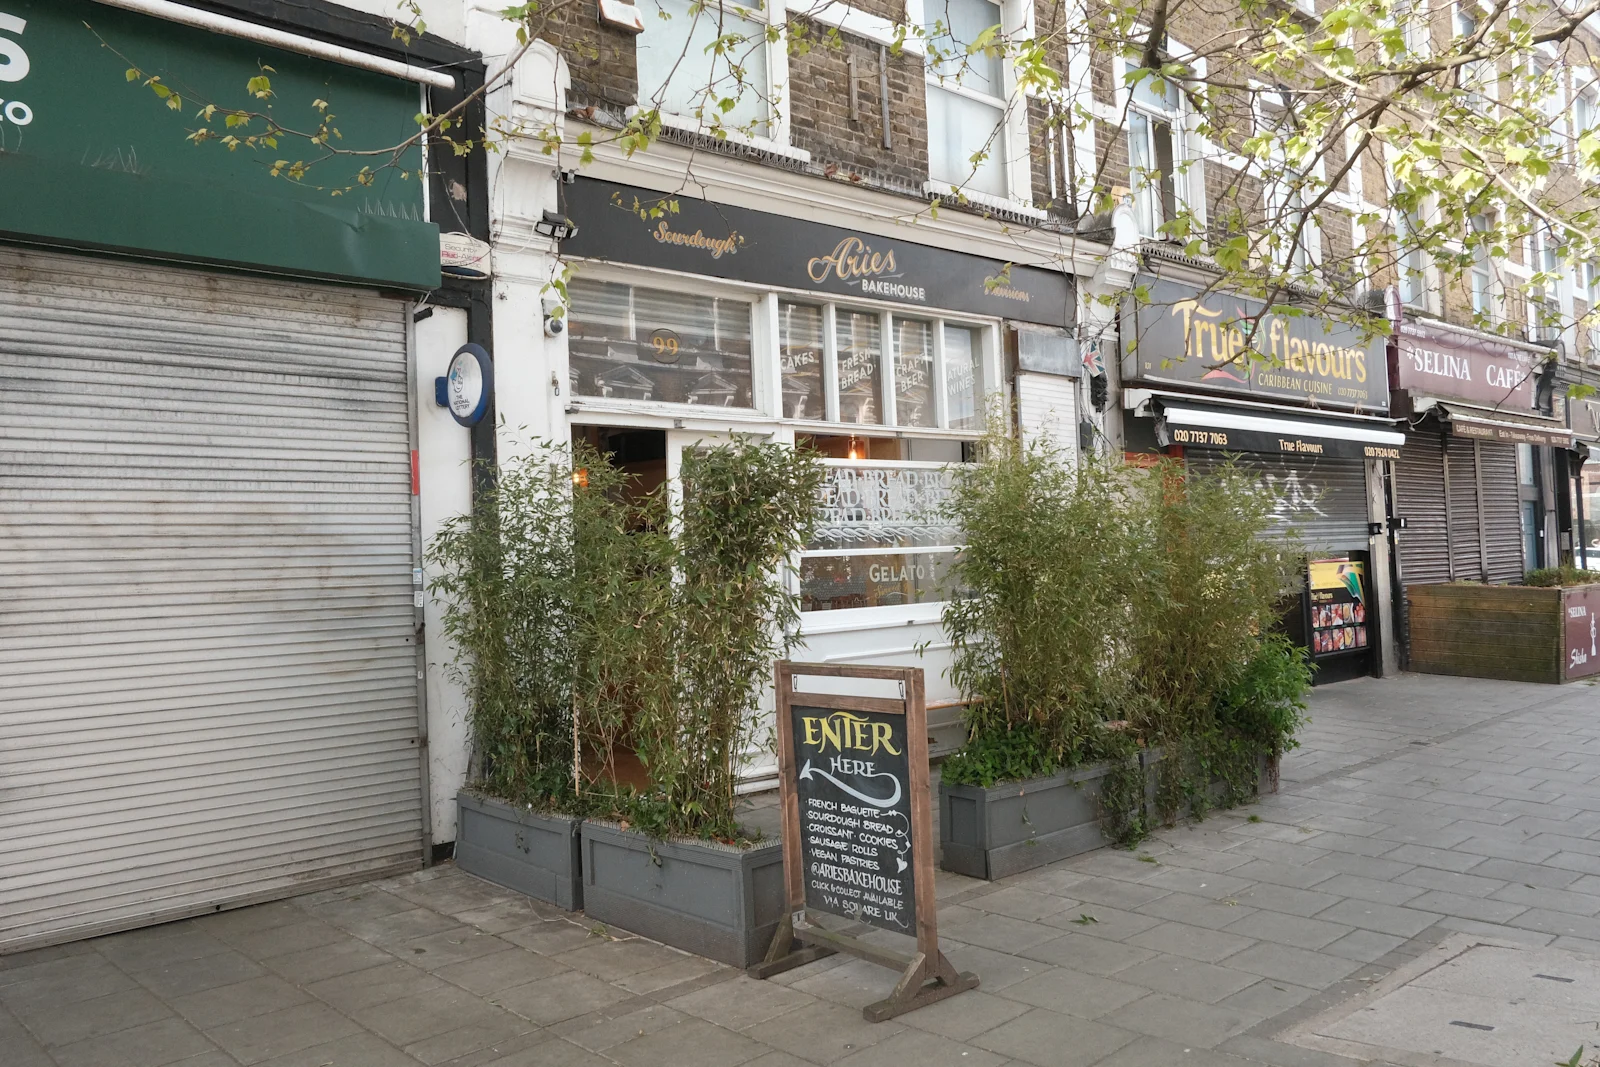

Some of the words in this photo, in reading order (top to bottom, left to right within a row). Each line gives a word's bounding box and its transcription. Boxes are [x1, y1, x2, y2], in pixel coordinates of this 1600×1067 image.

[654, 220, 737, 259] Sourdough
[807, 237, 897, 283] Aries
[861, 279, 926, 300] BAKEHOUSE
[1171, 298, 1244, 363] True
[653, 336, 679, 356] 99
[1270, 318, 1367, 383] flavours
[781, 351, 814, 371] CAKES
[842, 348, 871, 372] FRESH
[896, 353, 925, 377] CRAFT
[947, 357, 980, 381] ATURAL
[1414, 347, 1472, 381] SELINA
[1486, 365, 1523, 391] CAFÉ
[841, 364, 873, 390] BREAD
[900, 371, 924, 393] BEER
[948, 375, 975, 396] WINES
[1258, 373, 1301, 391] CARIBBEAN
[1303, 379, 1333, 396] CUISINE
[1174, 430, 1189, 442] 020
[1210, 432, 1228, 445] 7063
[1279, 439, 1295, 452] True
[1296, 440, 1324, 454] Flavours
[869, 563, 925, 583] GELATO
[802, 712, 902, 756] ENTER
[829, 755, 876, 777] HERE
[808, 798, 838, 810] FRENCH
[841, 804, 880, 818] BAGUETTE
[808, 811, 860, 828] SOURDOUGH
[863, 821, 893, 834] BREAD
[809, 823, 854, 839] CROISSANT
[859, 833, 899, 850] COOKIES
[810, 836, 848, 851] SAUSAGE
[852, 844, 878, 857] ROLLS
[811, 848, 837, 862] VEGAN
[841, 855, 880, 871] PASTRIES
[811, 862, 902, 895] @ARIESBAKEHOUSE
[811, 880, 830, 892] CLICK
[863, 892, 904, 910] AVAILABLE
